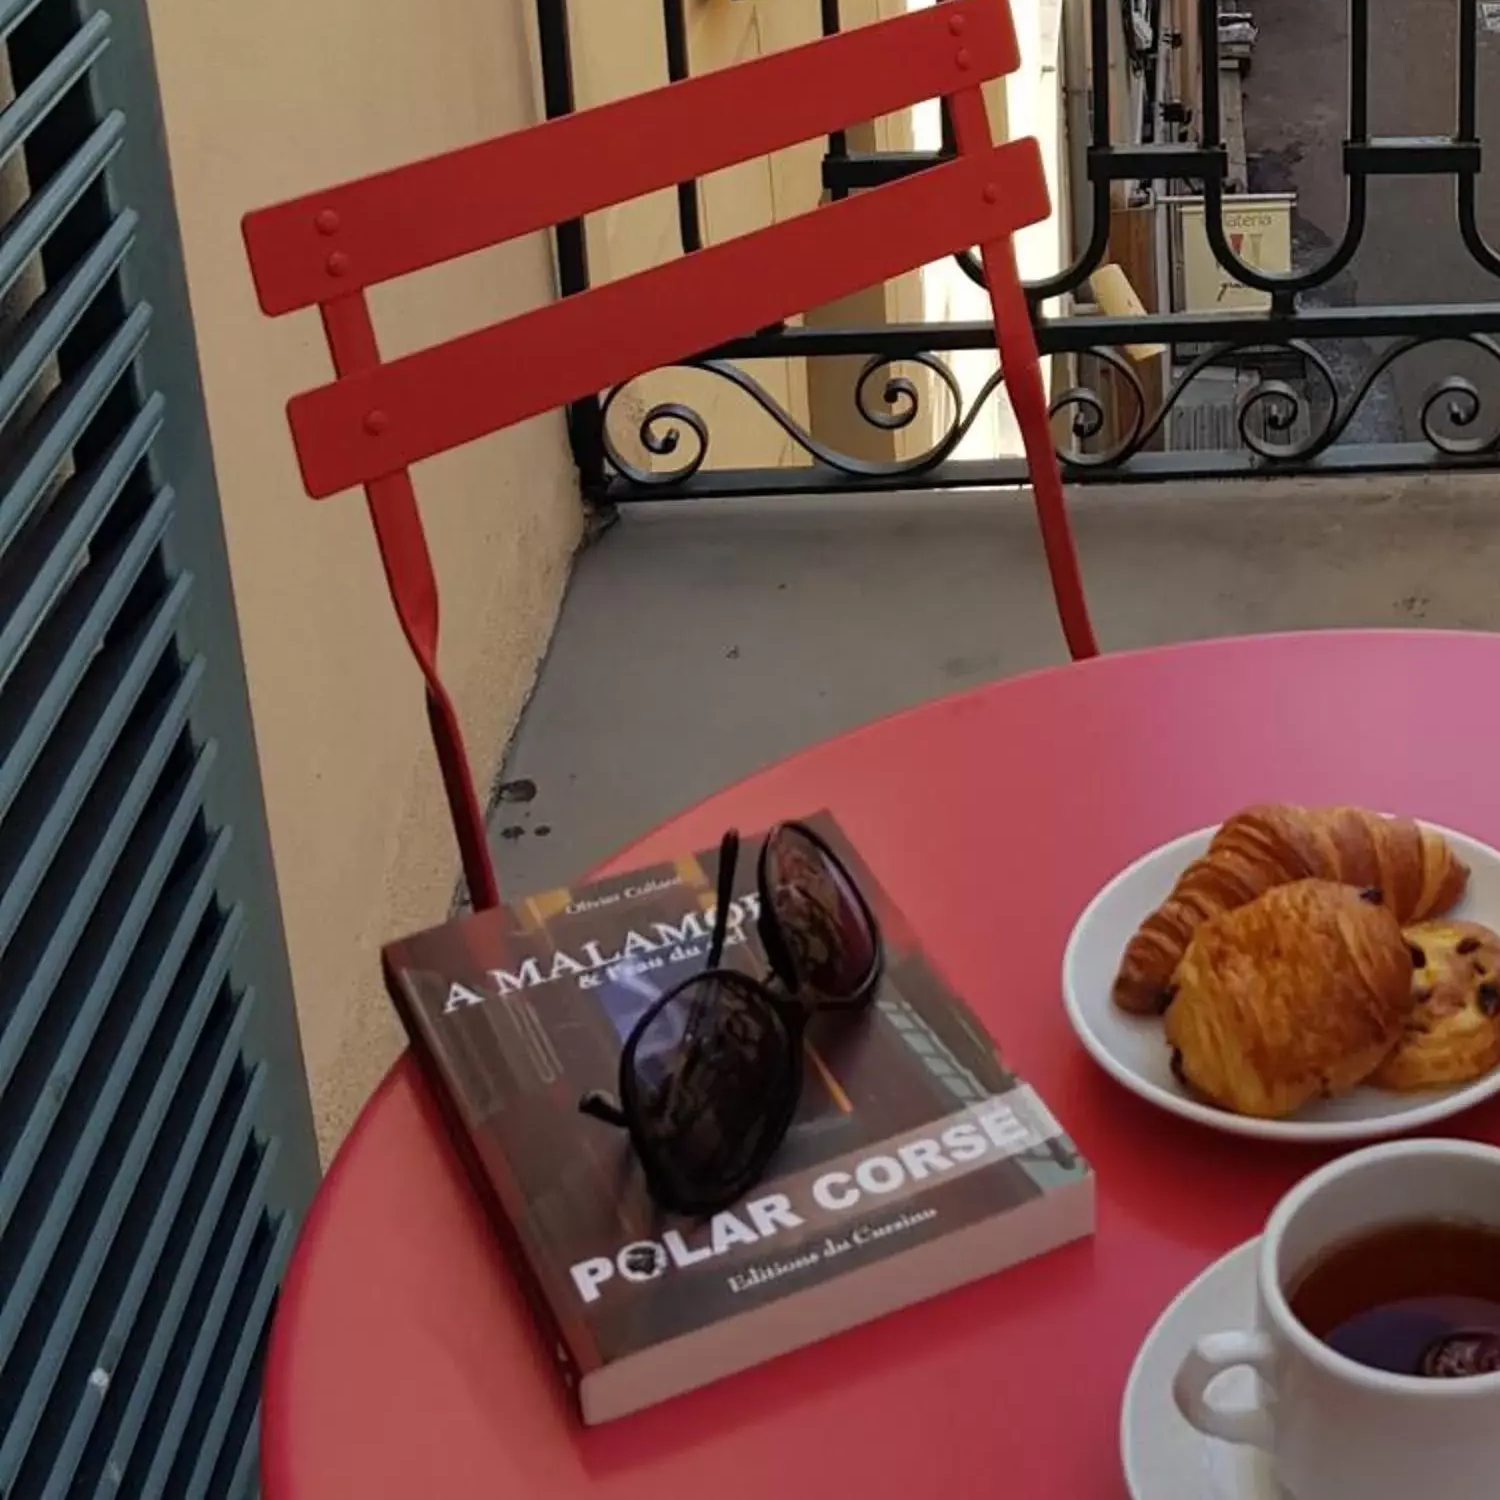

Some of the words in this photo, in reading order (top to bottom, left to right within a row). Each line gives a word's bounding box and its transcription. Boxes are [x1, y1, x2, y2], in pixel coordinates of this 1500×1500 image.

[578, 973, 603, 991] &
[669, 945, 702, 963] du
[443, 982, 486, 1014] A
[569, 1192, 806, 1303] POLAR
[811, 1103, 1030, 1211] CORSE
[823, 1235, 852, 1258] du
